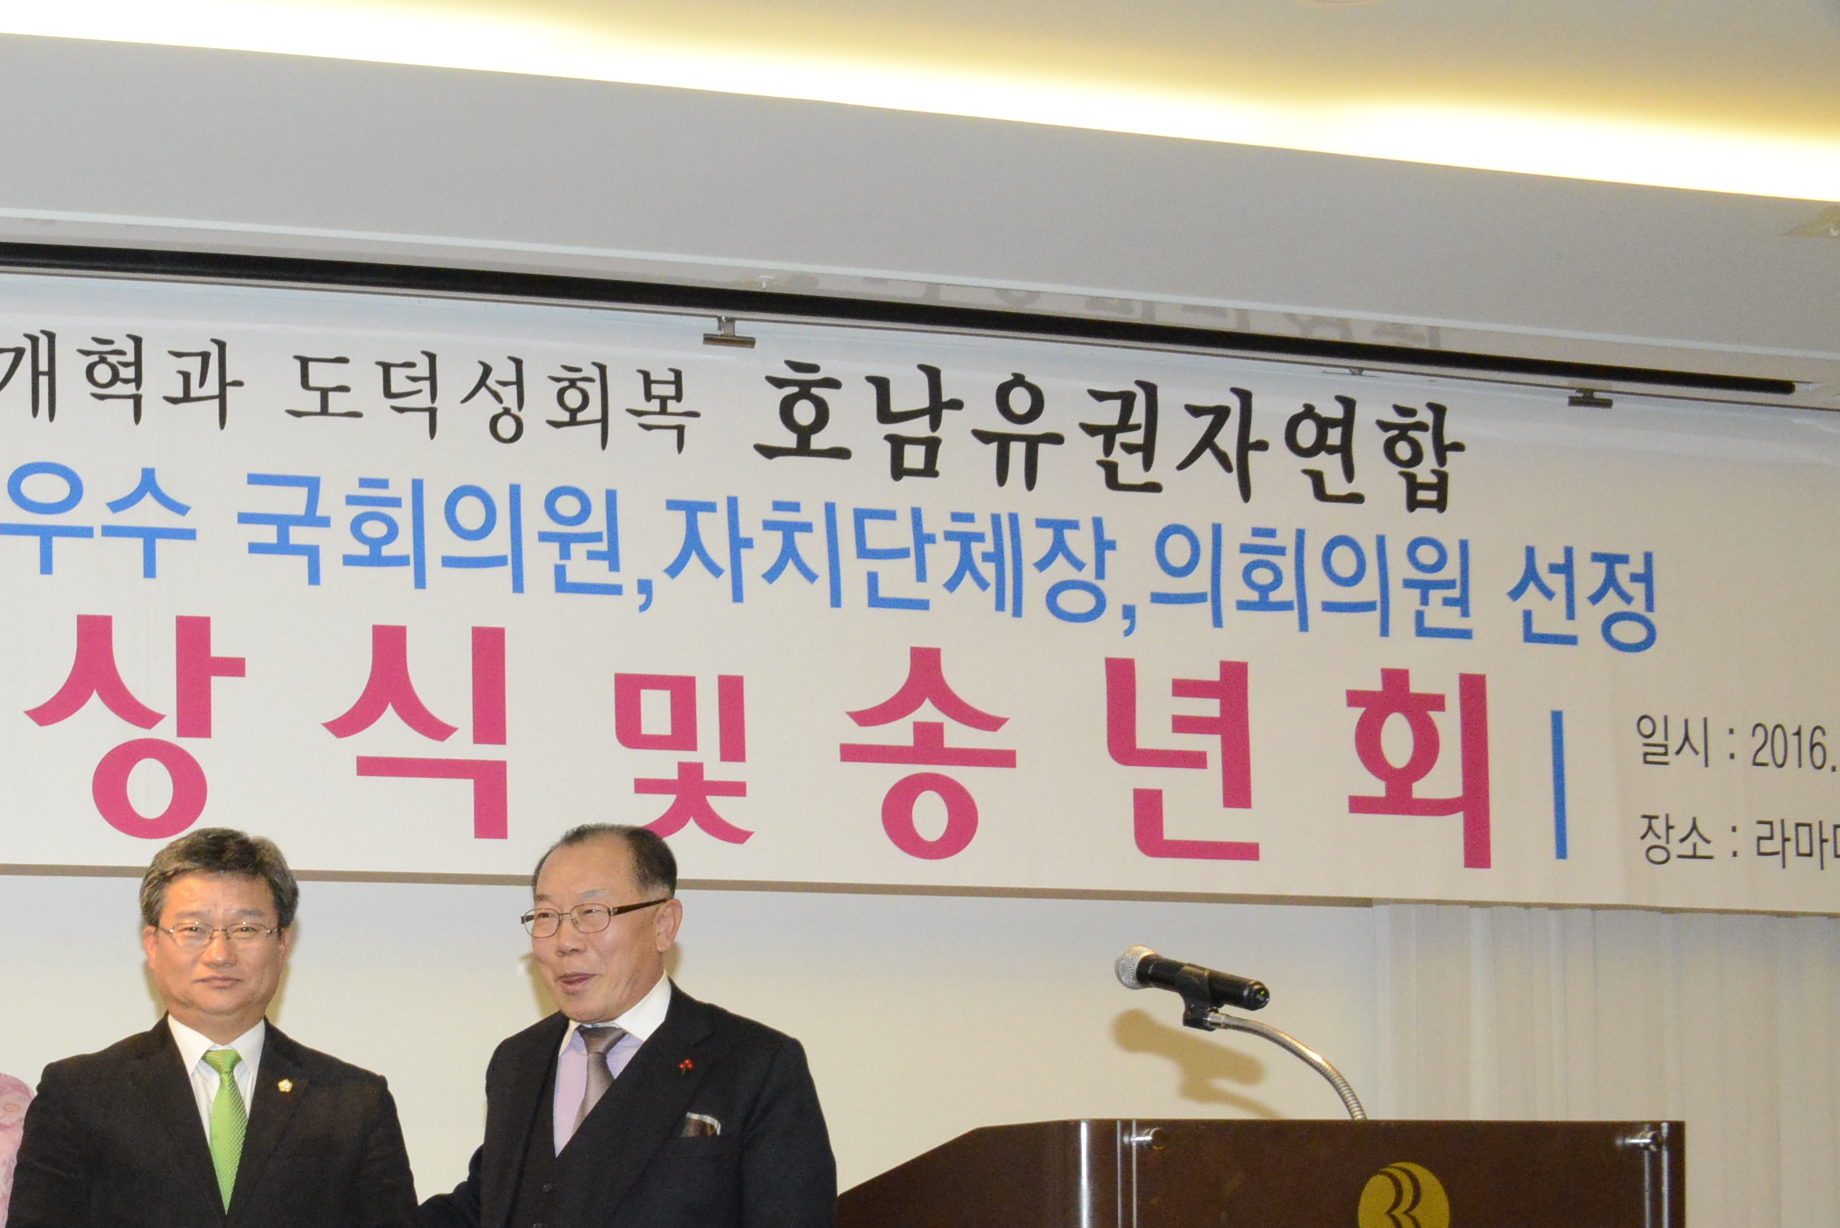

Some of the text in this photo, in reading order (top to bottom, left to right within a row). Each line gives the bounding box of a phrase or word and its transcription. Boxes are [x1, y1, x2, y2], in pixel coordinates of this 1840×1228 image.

[285, 350, 702, 455] 도덕성회복
[753, 358, 1466, 514] 호남유권자연합
[1507, 545, 1659, 653] 선정
[613, 672, 755, 846] 및
[839, 645, 1492, 869] 송년회
[1636, 714, 1709, 768] 일시
[1751, 722, 1837, 773] 2016.
[1639, 813, 1715, 865] 장소
[1755, 818, 1840, 871] 라마
